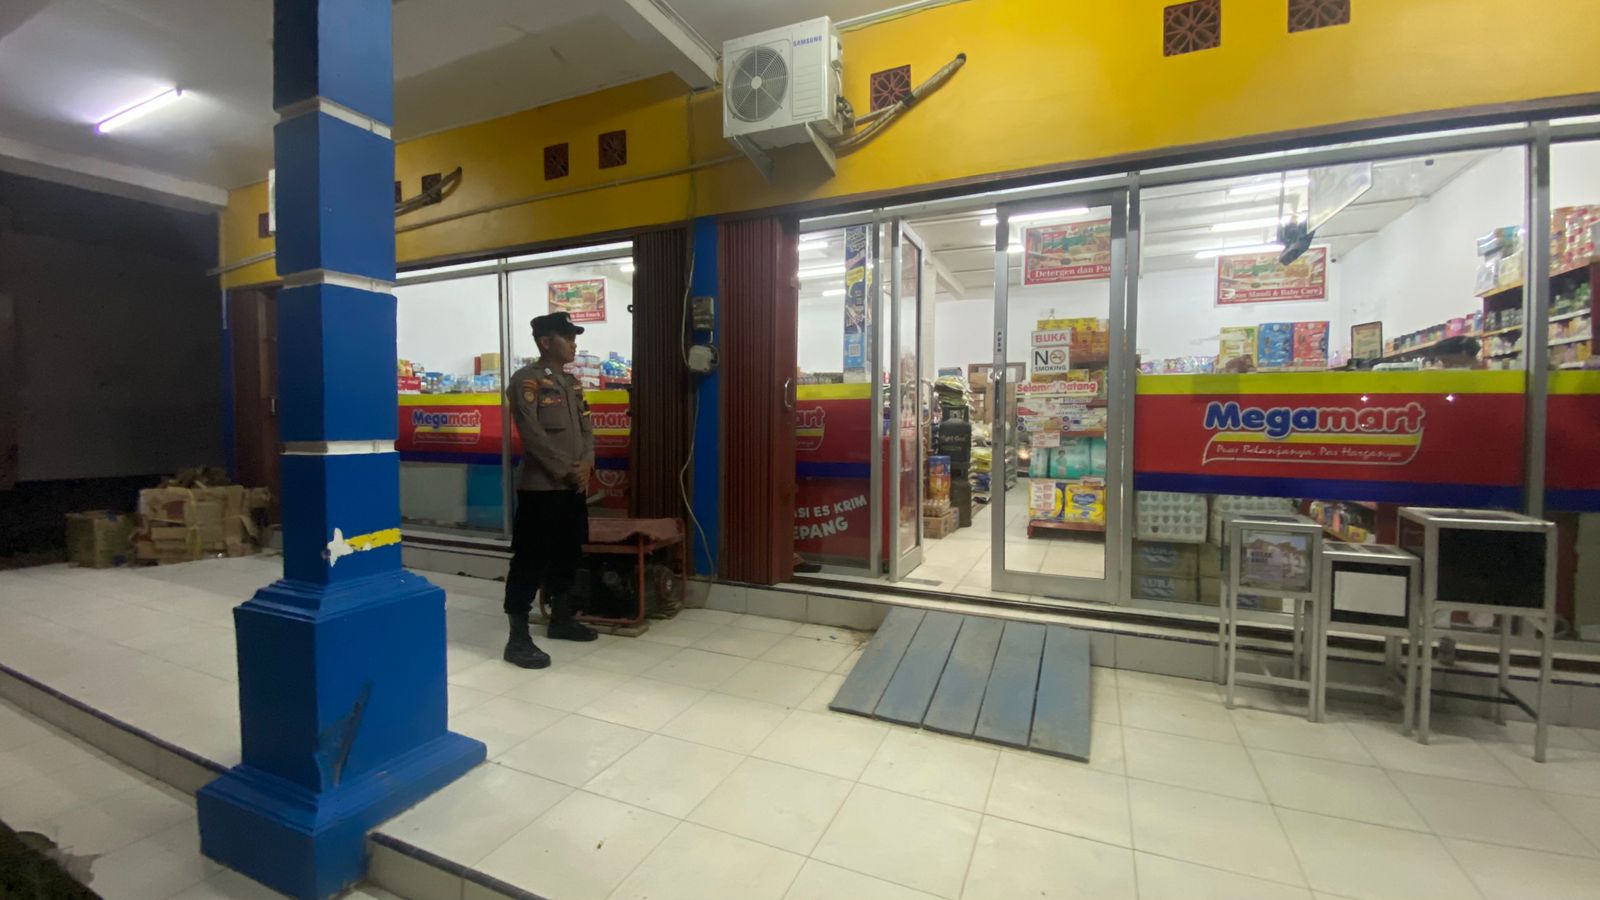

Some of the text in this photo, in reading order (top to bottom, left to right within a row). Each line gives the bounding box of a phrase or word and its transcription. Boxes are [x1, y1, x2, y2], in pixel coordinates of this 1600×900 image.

[793, 35, 822, 47] SAMSUNG
[1034, 268, 1075, 278] Detergen
[1076, 266, 1094, 274] dan
[1271, 288, 1280, 297] &
[1280, 287, 1299, 297] Baby
[1300, 286, 1319, 296] Care
[1035, 333, 1067, 343] BUKA
[1060, 381, 1097, 393] Datang
[412, 408, 481, 431] Megamart
[1203, 401, 1425, 439] Megamart
[1320, 446, 1338, 456] Pas
[794, 494, 867, 518] SI ES KRIM
[793, 516, 849, 540] EPANG
